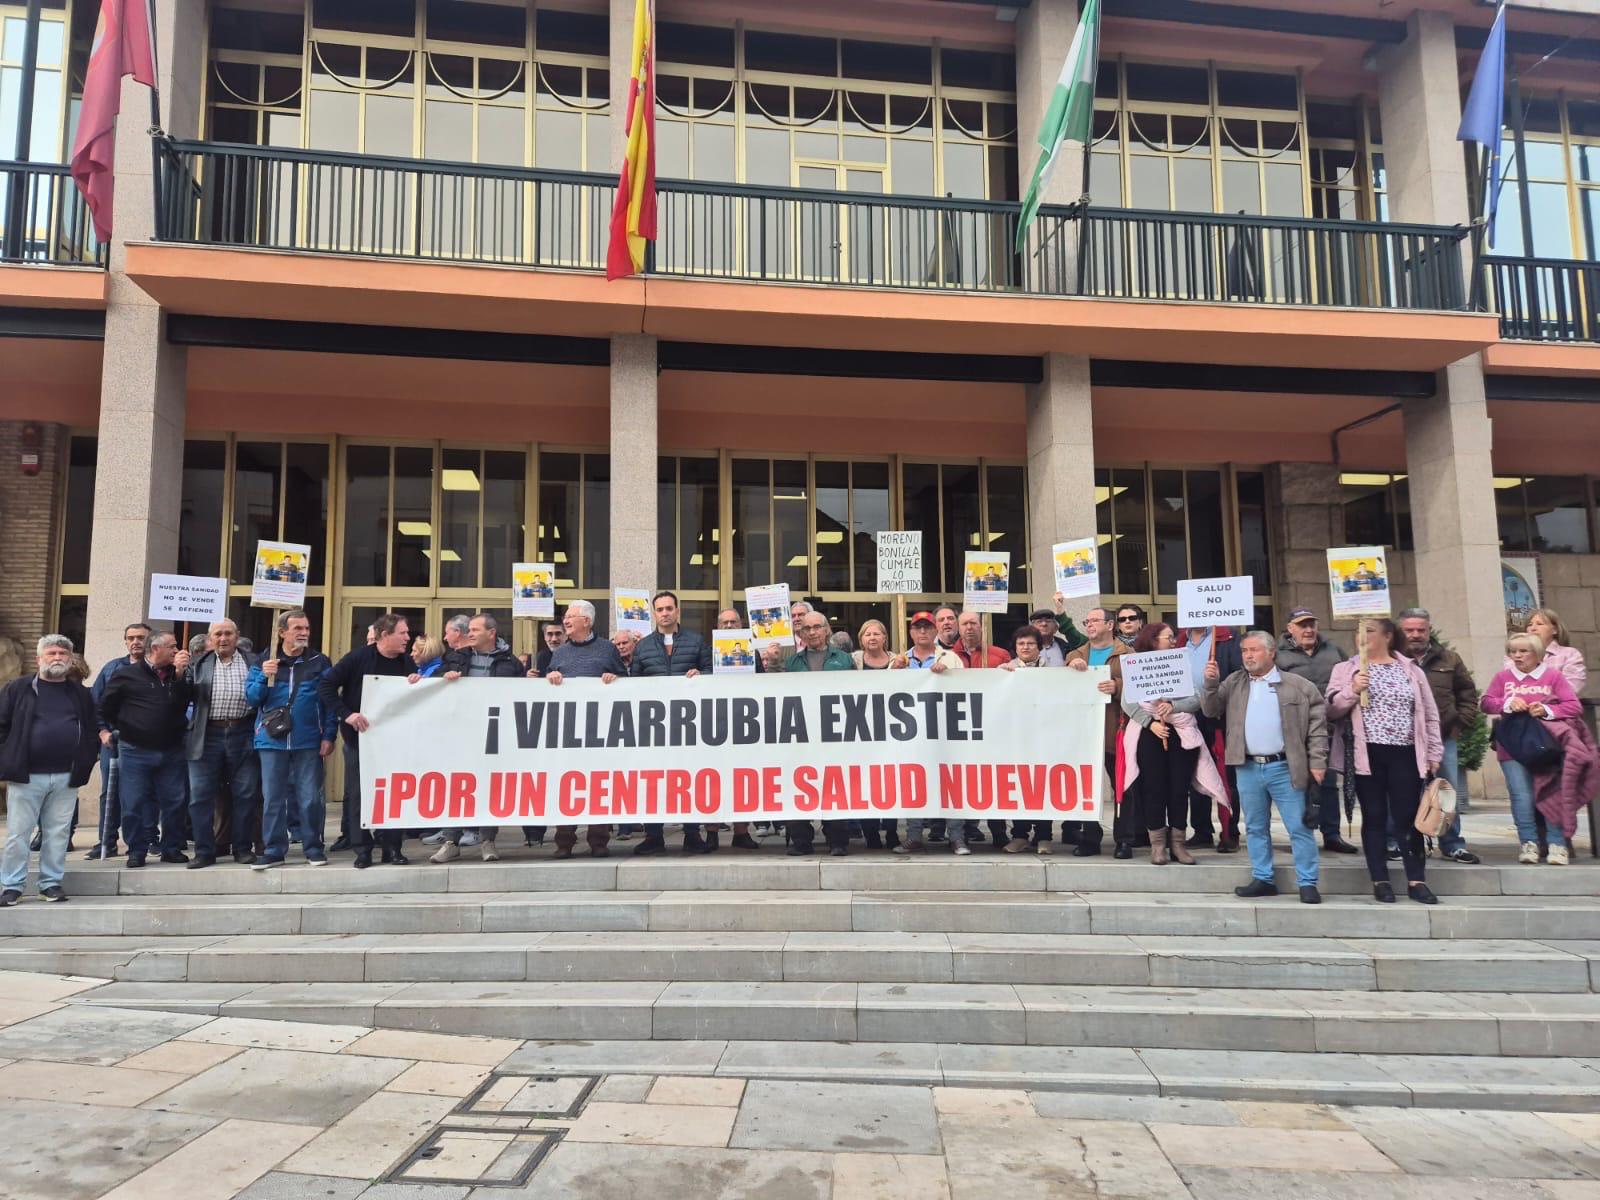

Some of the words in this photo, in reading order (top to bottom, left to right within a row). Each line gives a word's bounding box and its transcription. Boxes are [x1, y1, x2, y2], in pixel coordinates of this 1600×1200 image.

[879, 546, 920, 557] BONILLA
[880, 558, 920, 569] CUMPLE
[893, 570, 904, 579] LO
[159, 584, 190, 592] NUESTRA
[881, 580, 922, 592] PROMETIDO
[1197, 584, 1231, 592] SALUD
[178, 606, 215, 614] DEFIENDE
[1188, 609, 1245, 619] RESPONDE
[1154, 653, 1184, 662] SANIDAD
[1142, 663, 1170, 671] PRIVADA
[1155, 670, 1184, 678] SANIDAD
[1136, 681, 1165, 689] PUBLICA
[1145, 687, 1174, 696] CALIDAD
[513, 695, 809, 749] VILLARRUBIA
[820, 692, 984, 743] EXISTE!
[371, 771, 477, 824] ¡POR
[488, 771, 547, 817] UN
[558, 768, 721, 817] CENTRO
[733, 767, 783, 813] DE
[793, 762, 927, 812] SALUD
[939, 763, 1094, 812] NUEVO!
